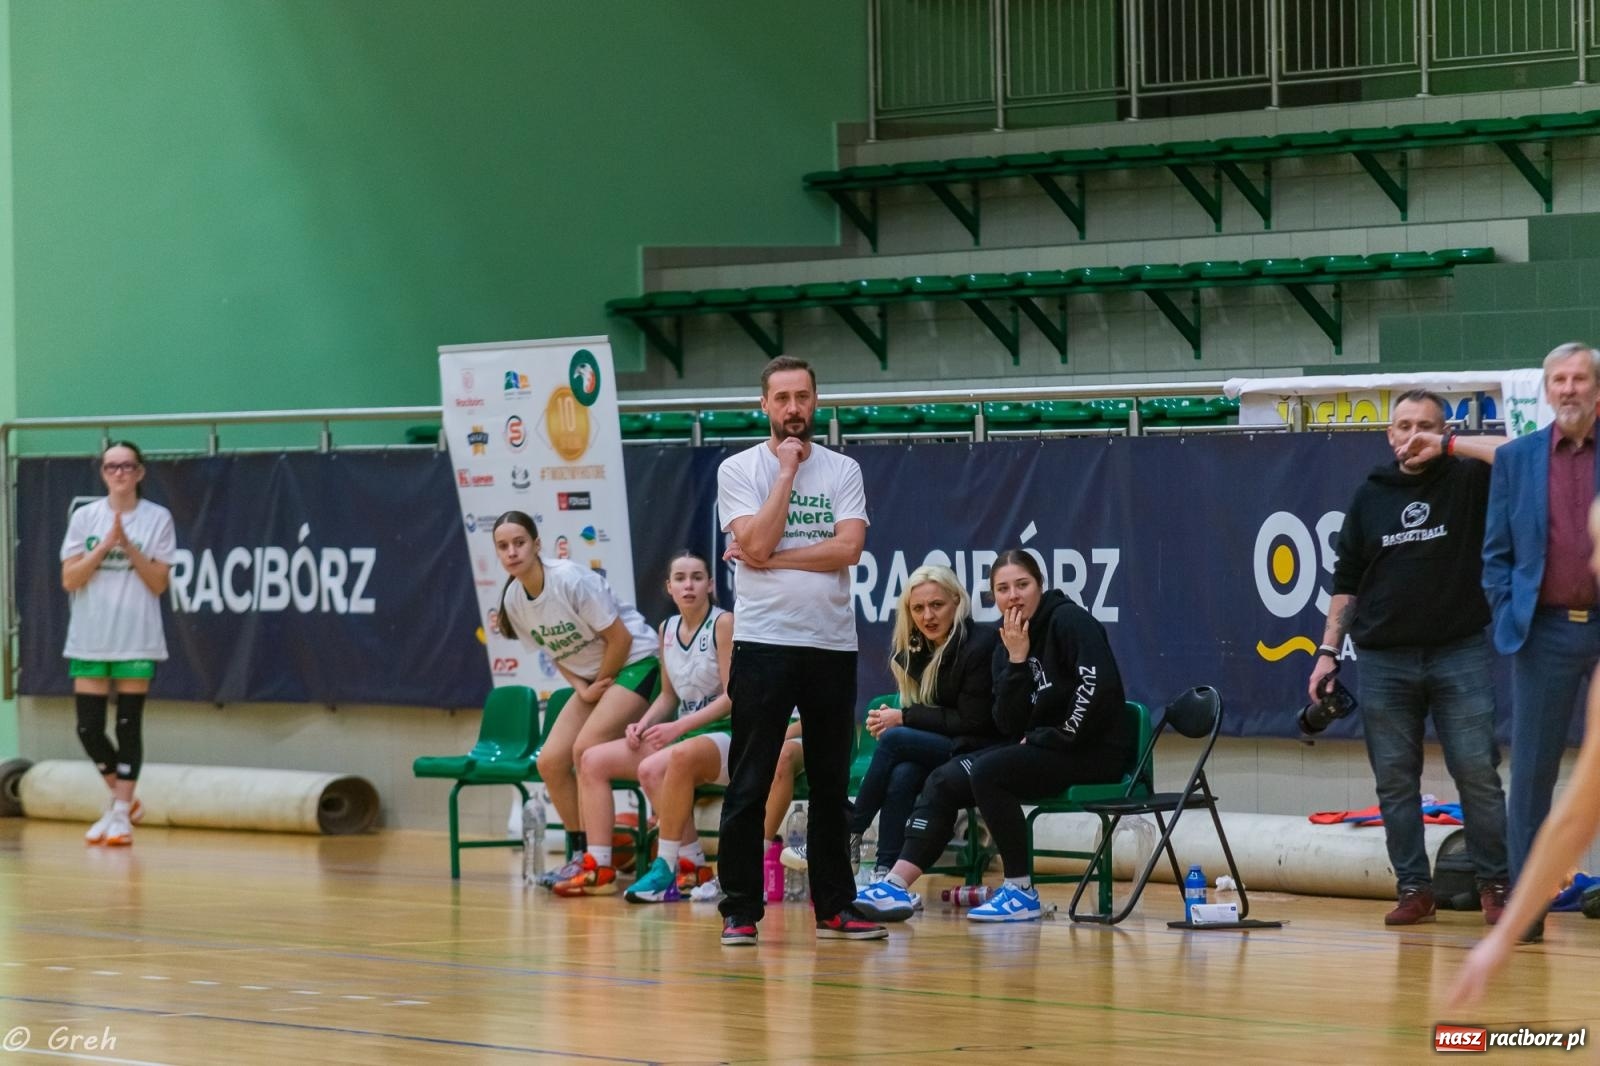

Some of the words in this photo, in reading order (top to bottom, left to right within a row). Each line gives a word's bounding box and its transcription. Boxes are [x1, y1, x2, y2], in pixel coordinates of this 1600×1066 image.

[789, 490, 832, 509] Zuzia
[787, 510, 834, 526] Wera
[1381, 524, 1449, 548] BASKETBALL
[169, 522, 376, 614] RACIBÓRZ
[849, 520, 1121, 623] RAIBRZ
[538, 620, 577, 637] Zuzia
[547, 631, 583, 652] Wera
[1062, 665, 1097, 735] ZUZANKA
